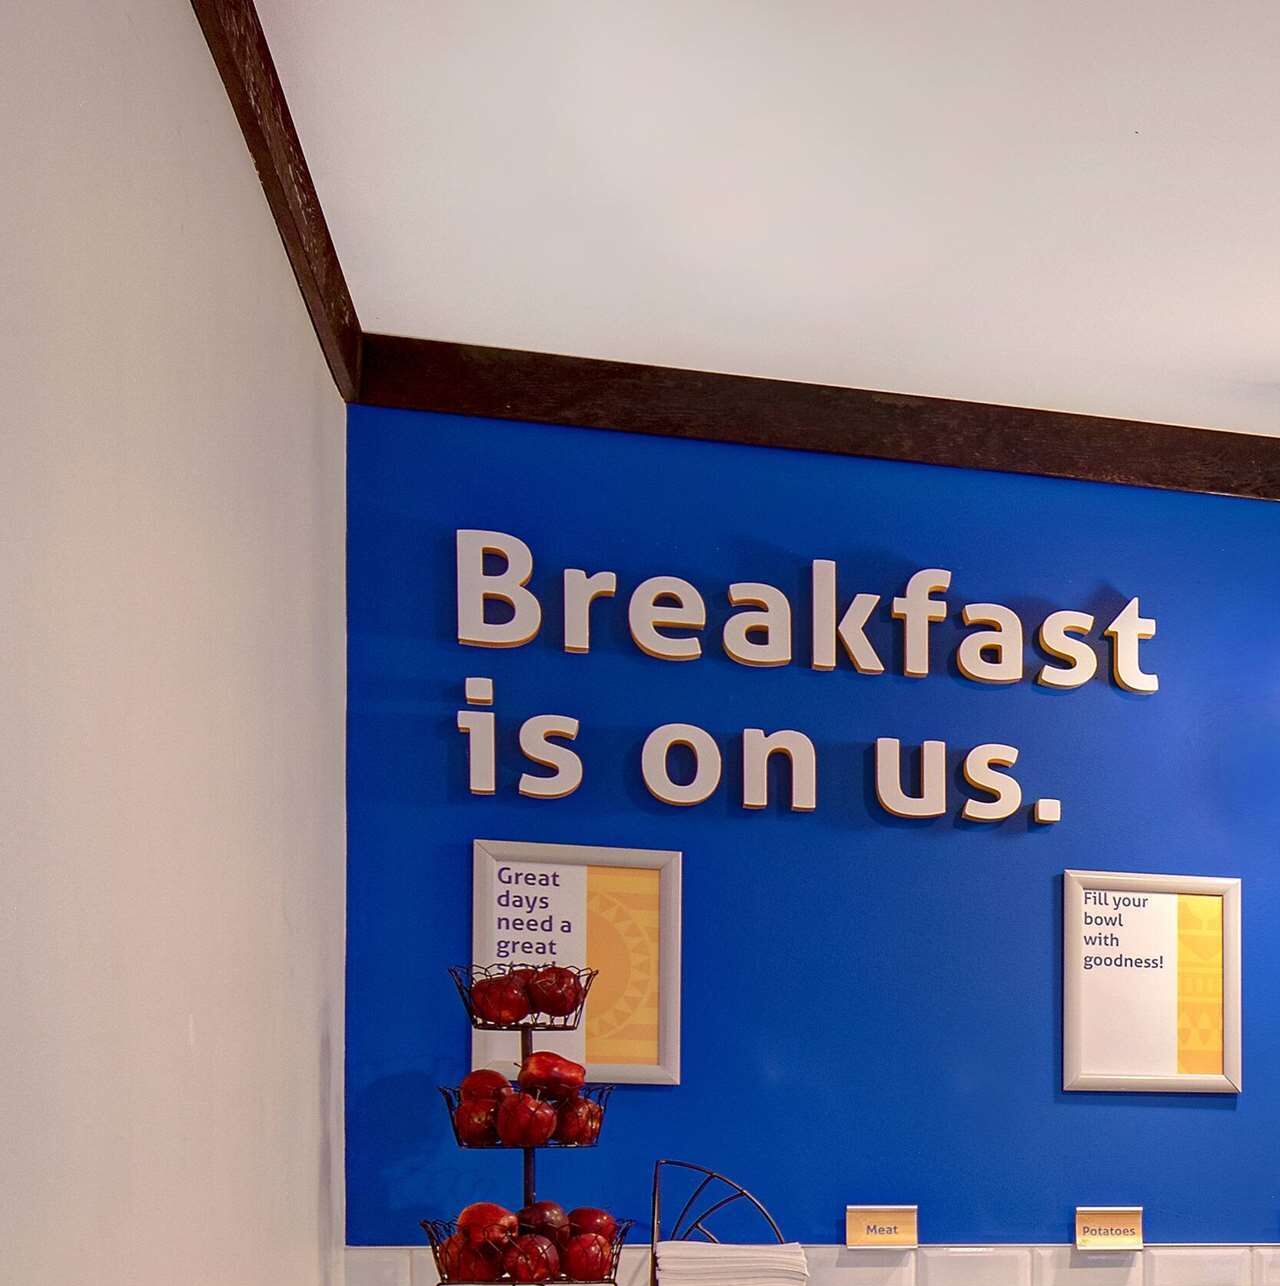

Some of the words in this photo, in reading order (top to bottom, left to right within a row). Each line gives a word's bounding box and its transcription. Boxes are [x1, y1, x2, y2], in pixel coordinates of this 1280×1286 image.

[456, 529, 1159, 694] Breakfast
[457, 677, 583, 799] is
[641, 723, 816, 812] on
[875, 737, 1061, 824] us.
[497, 867, 560, 887] Great
[497, 890, 549, 913] days
[1084, 891, 1109, 906] Fill
[1112, 896, 1149, 910] your
[497, 915, 553, 932] need
[560, 919, 572, 933] a
[1084, 911, 1124, 927] bowl
[496, 939, 557, 958] great
[1083, 932, 1120, 947] with
[1083, 953, 1164, 970] goodness!
[866, 1224, 898, 1236] Meat
[1083, 1226, 1136, 1236] Potatoes
